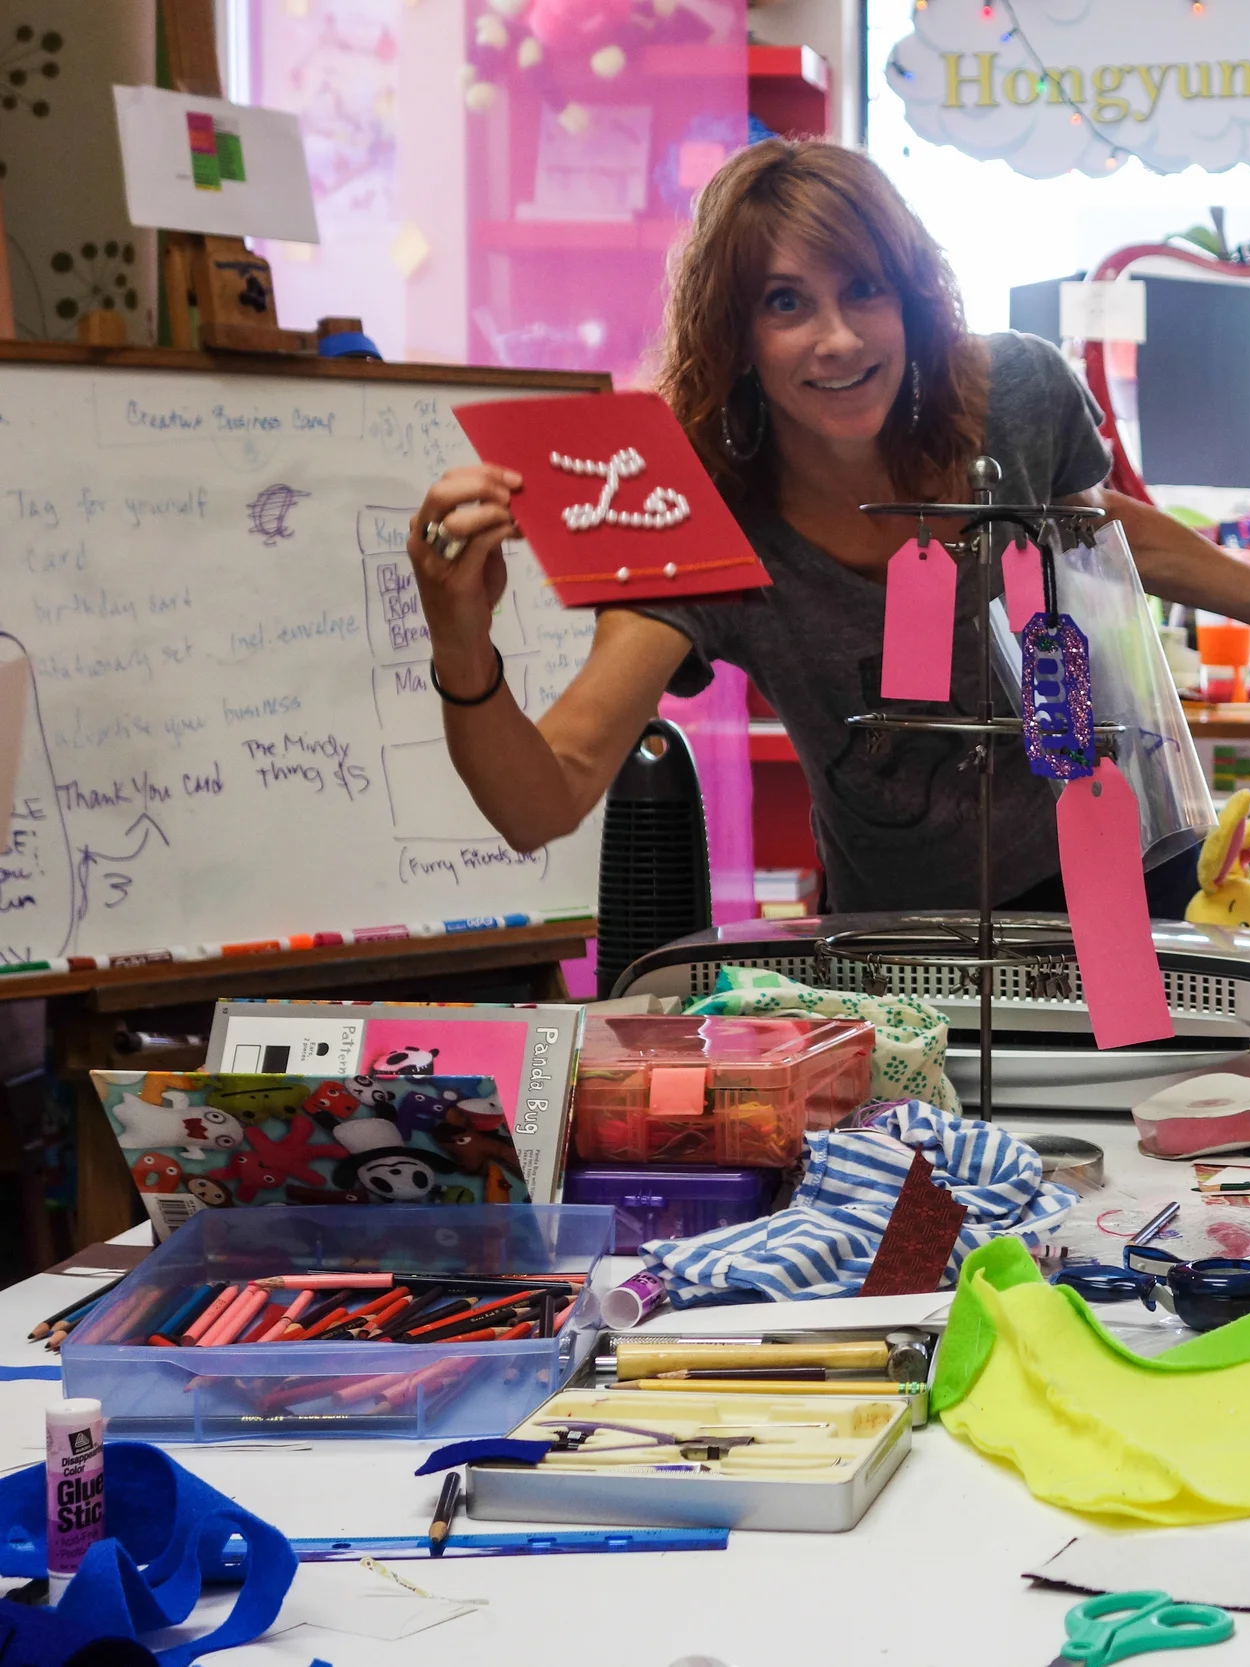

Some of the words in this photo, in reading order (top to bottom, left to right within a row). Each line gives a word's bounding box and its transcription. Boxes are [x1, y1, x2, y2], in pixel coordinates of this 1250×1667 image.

[337, 1025, 357, 1075] Pattern
[528, 1026, 560, 1093] Panda
[516, 1099, 549, 1134] Bug
[63, 1464, 85, 1477] Color
[57, 1472, 104, 1507] Glue
[57, 1501, 103, 1534] Stic
